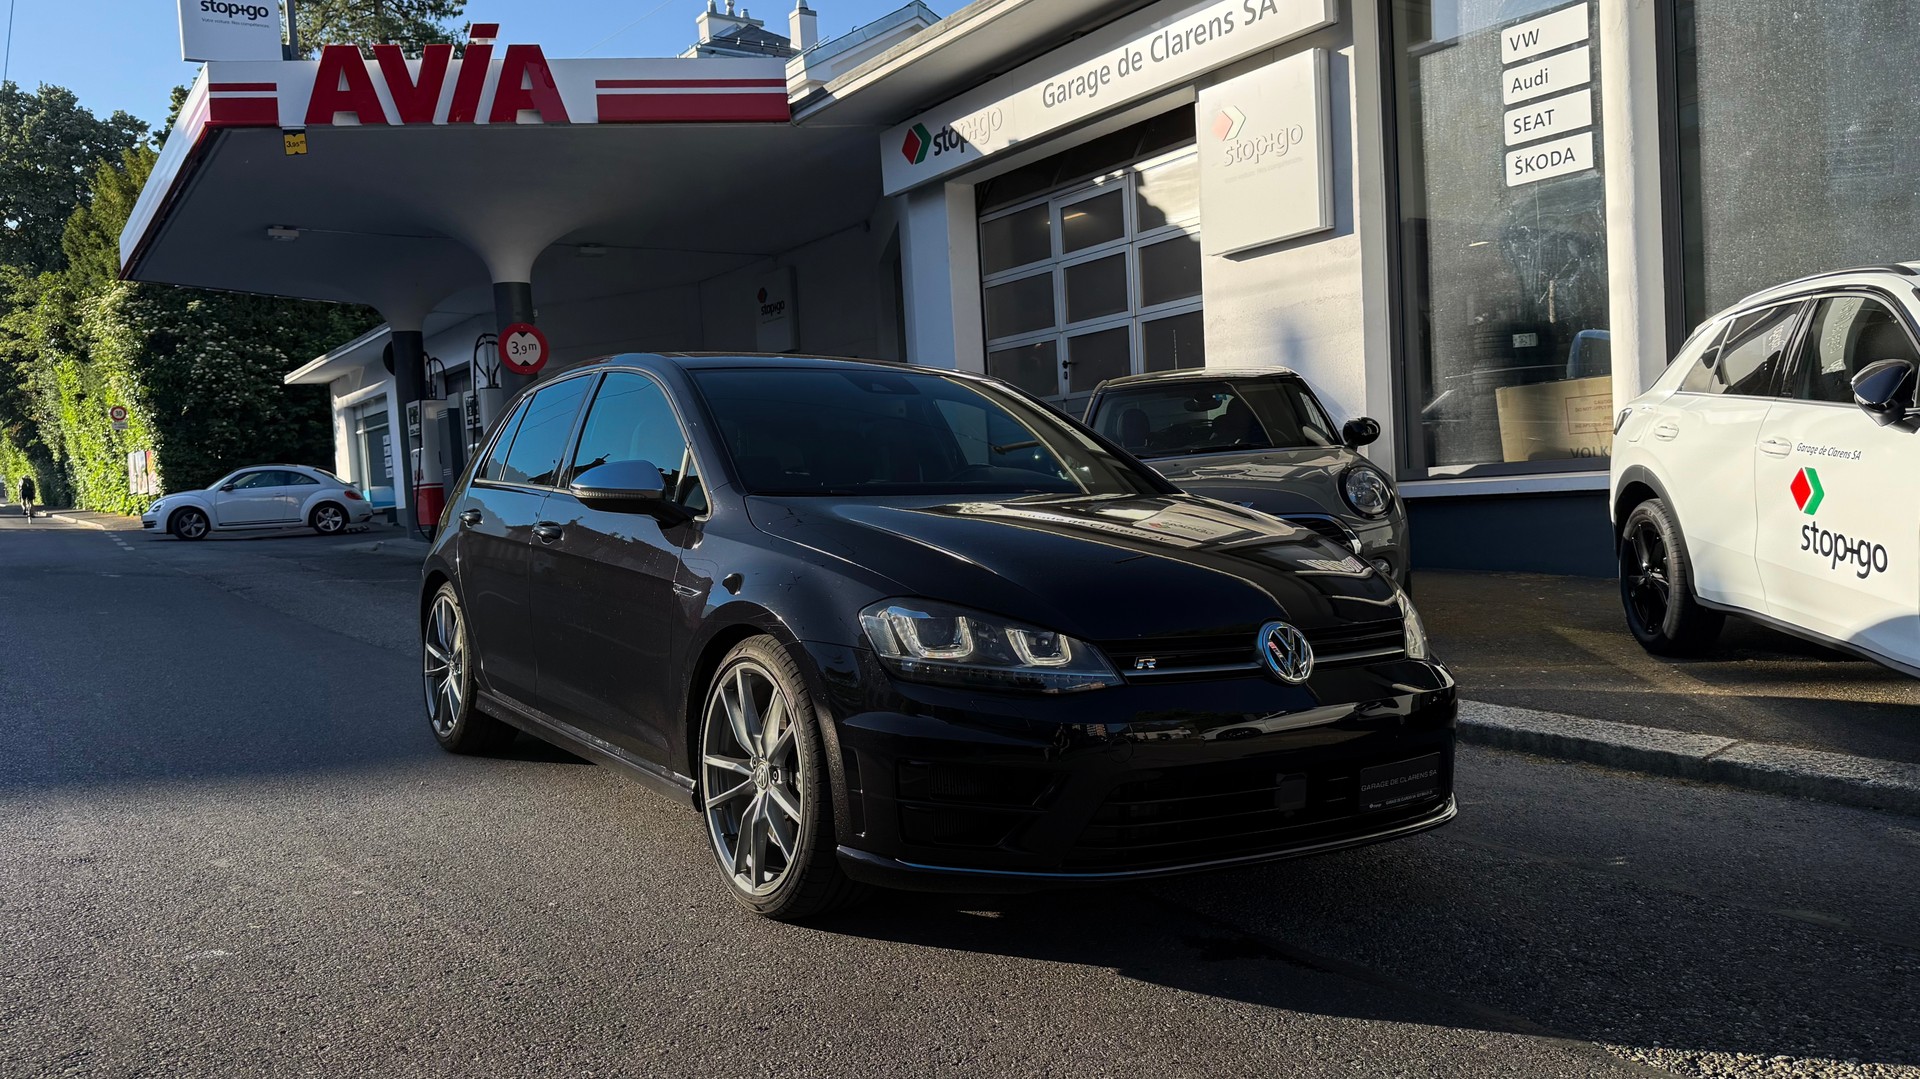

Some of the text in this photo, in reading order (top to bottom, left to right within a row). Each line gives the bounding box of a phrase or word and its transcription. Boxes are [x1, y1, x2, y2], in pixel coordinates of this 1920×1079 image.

[200, 0, 269, 20] stop+go
[1509, 28, 1540, 51] VW
[1042, 0, 1279, 109] Garage de Clarens SA
[1511, 68, 1549, 93] Audi
[933, 106, 1003, 156] stop+go
[1513, 109, 1555, 135] SEAT
[1223, 124, 1304, 167] stop+go
[1515, 147, 1576, 176] ŠKODA
[1569, 445, 1612, 458] VOLK
[1797, 442, 1861, 460] Garage de Clarens SA
[1801, 521, 1888, 579] stop+go
[1361, 769, 1438, 792] GARAGE DE CLARENS SA
